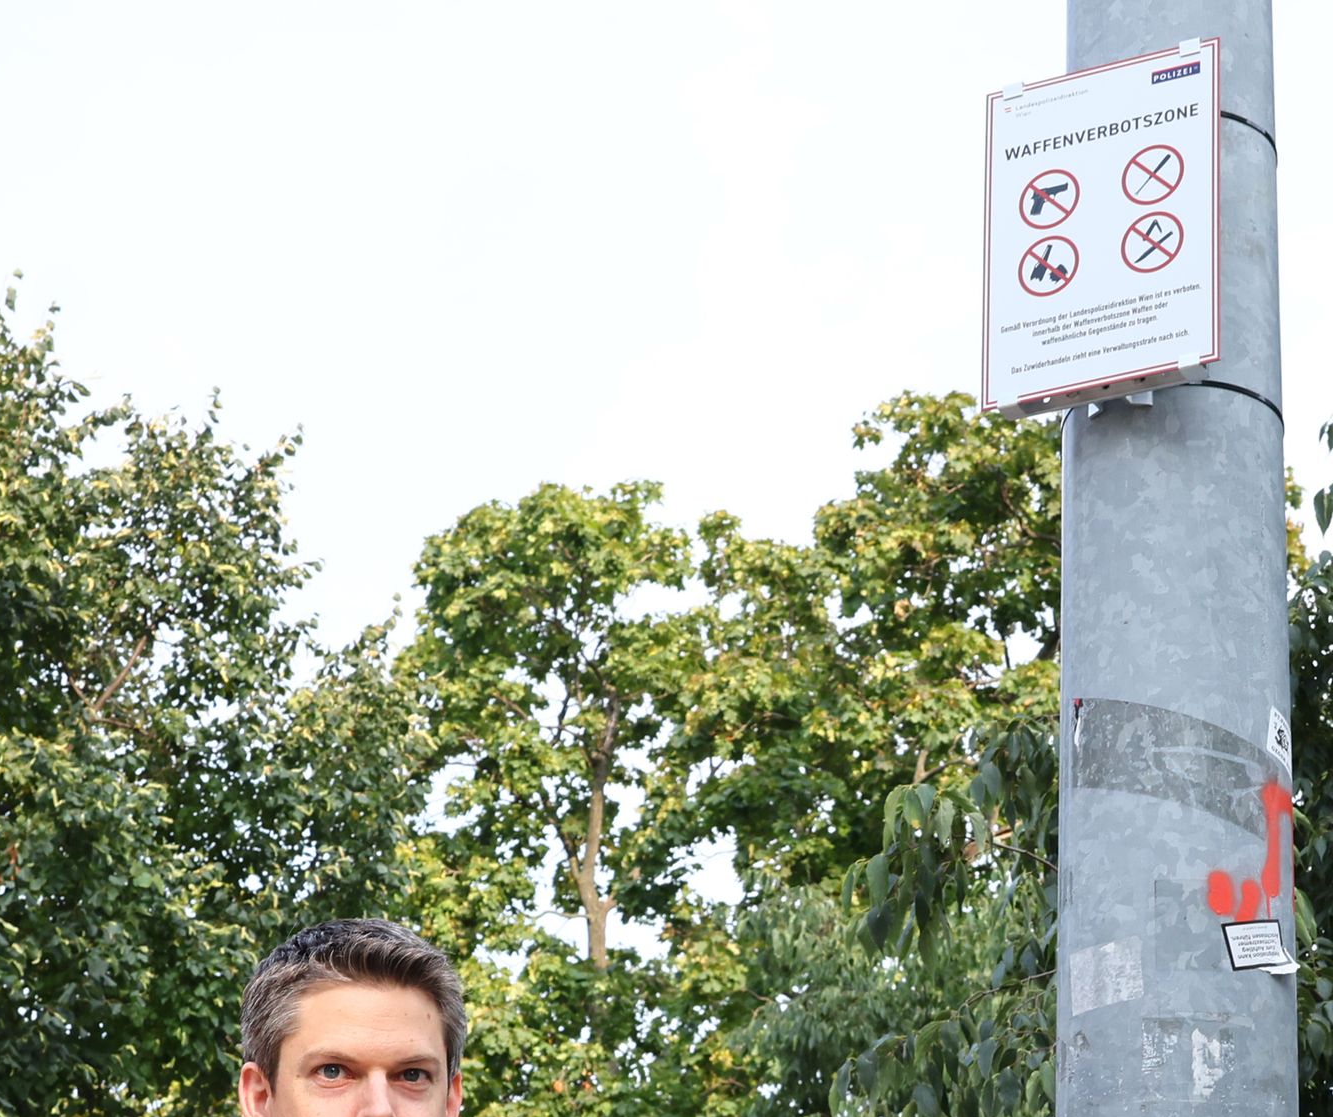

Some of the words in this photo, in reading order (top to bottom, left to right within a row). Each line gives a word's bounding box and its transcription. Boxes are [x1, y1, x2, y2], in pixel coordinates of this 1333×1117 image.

[1153, 66, 1193, 83] POLIZEI
[1004, 102, 1199, 161] WAFFENVERBOTSZONE
[1000, 322, 1021, 334] Gemäß
[1023, 315, 1057, 329] Verordnung
[1058, 312, 1068, 321] der
[1069, 296, 1137, 319] Landespolizeidirektion
[1138, 293, 1154, 303] Wien
[1155, 290, 1163, 299] ist
[1164, 289, 1172, 297] es
[1173, 282, 1201, 296] verboten.
[1032, 324, 1061, 338] innerhalb
[1062, 322, 1072, 332] der
[1074, 309, 1130, 328] Waffenverbotszone
[1132, 304, 1153, 315] Waffen
[1154, 301, 1169, 311] oder
[1011, 366, 1023, 375] Das
[1023, 354, 1071, 372] Zuwiderhandeln
[1072, 351, 1088, 362] zieht
[1088, 347, 1101, 357] eine
[1102, 336, 1158, 356] Verwaltungsstrafe
[1159, 331, 1174, 343] nach
[1175, 328, 1190, 339] sich.
[1041, 330, 1087, 347] waffenähnliche
[1088, 319, 1127, 337] Gegenstände
[1128, 319, 1136, 328] zu
